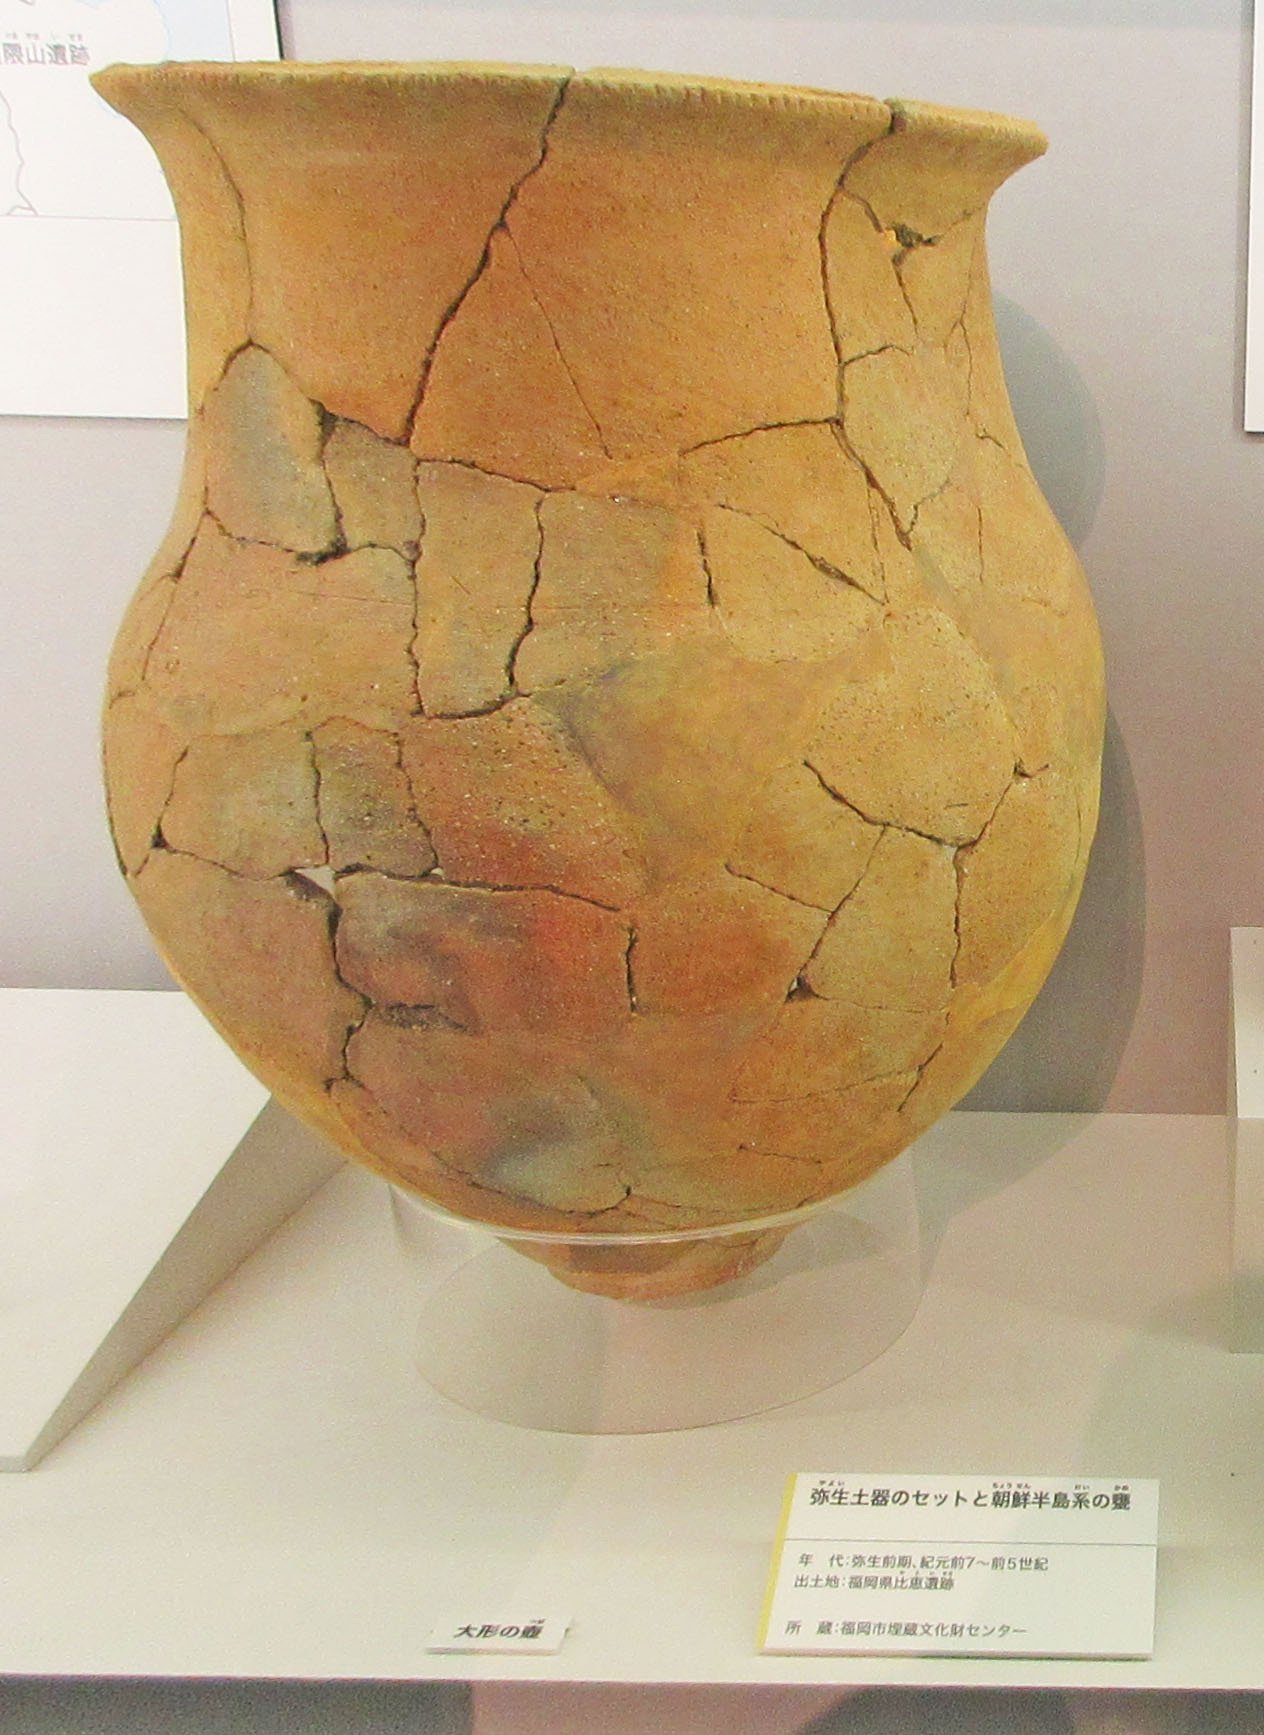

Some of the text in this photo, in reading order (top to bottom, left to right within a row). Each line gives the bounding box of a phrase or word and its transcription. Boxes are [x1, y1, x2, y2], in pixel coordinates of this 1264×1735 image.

[810, 1487, 1131, 1511] 弥生土器のセットと朝鮮半島系の甕
[798, 1553, 813, 1567] 年
